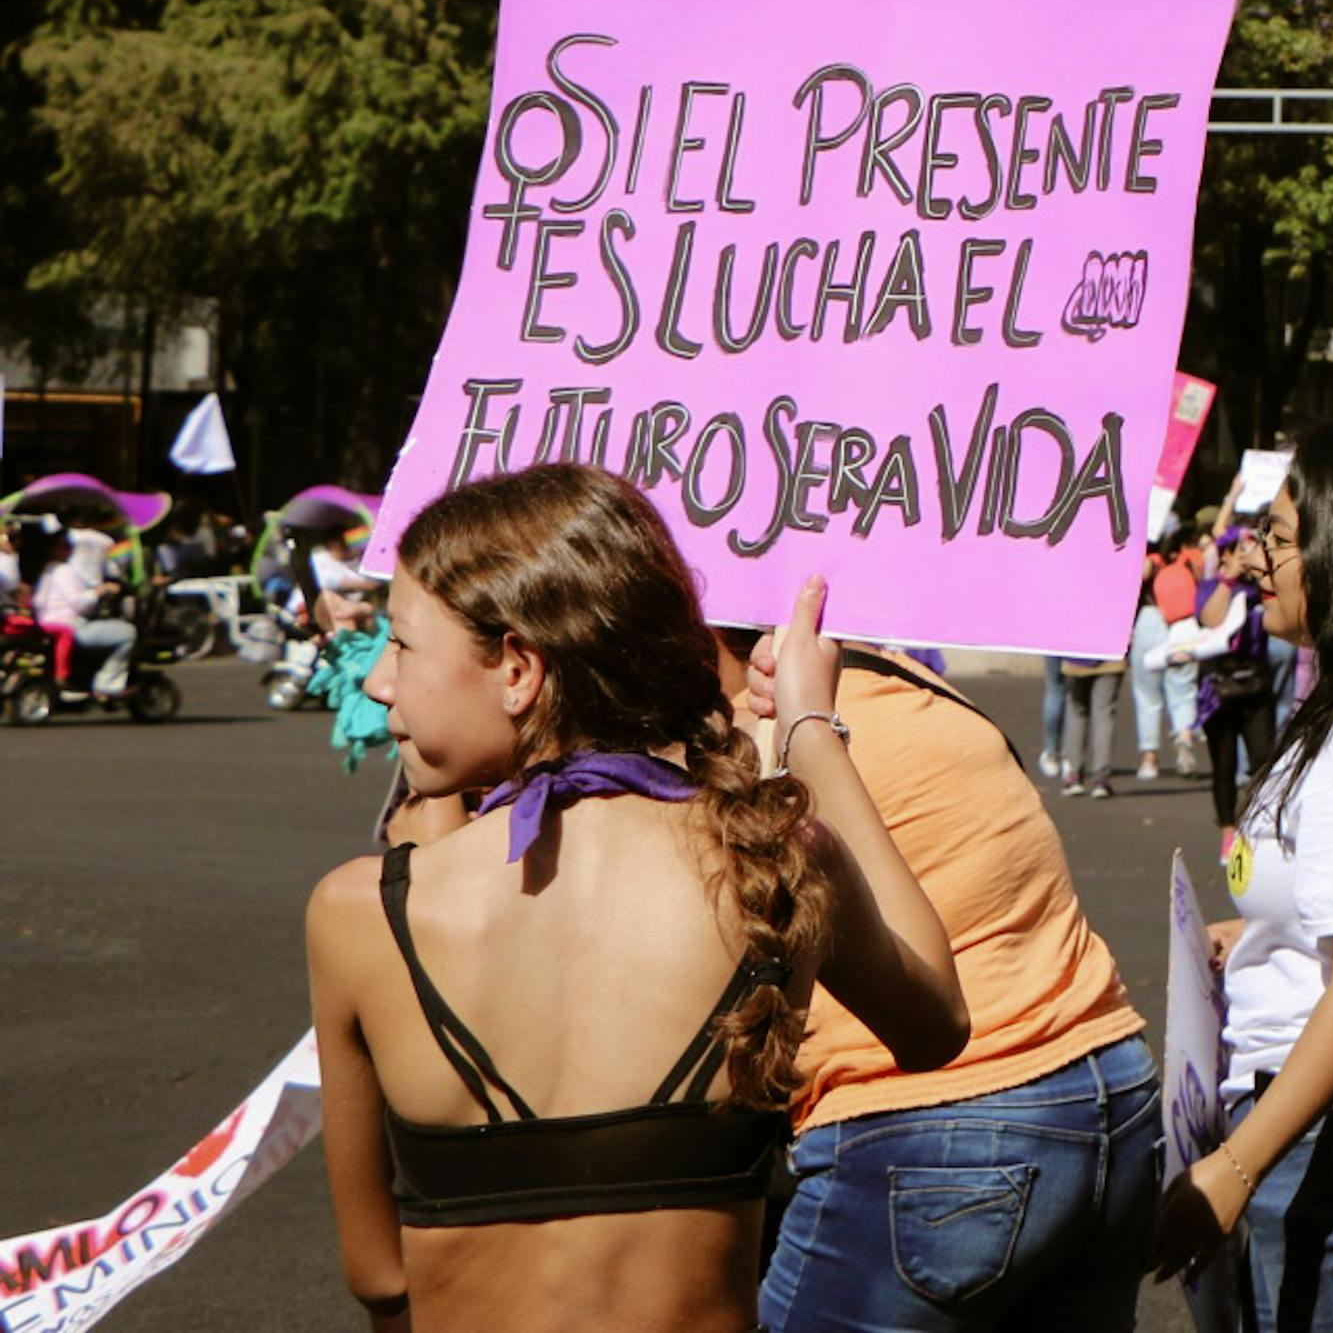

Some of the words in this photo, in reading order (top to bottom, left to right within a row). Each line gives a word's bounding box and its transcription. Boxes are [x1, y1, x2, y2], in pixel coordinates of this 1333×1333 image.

[547, 32, 652, 213] SI
[664, 81, 756, 214] EL
[793, 63, 1181, 221] PRESENTE
[519, 206, 642, 365] ES
[655, 221, 931, 360] LUCHA
[951, 238, 1044, 348] EL
[450, 378, 746, 528] FUTURO
[726, 395, 921, 557] SERA
[929, 383, 1131, 551] VIDA
